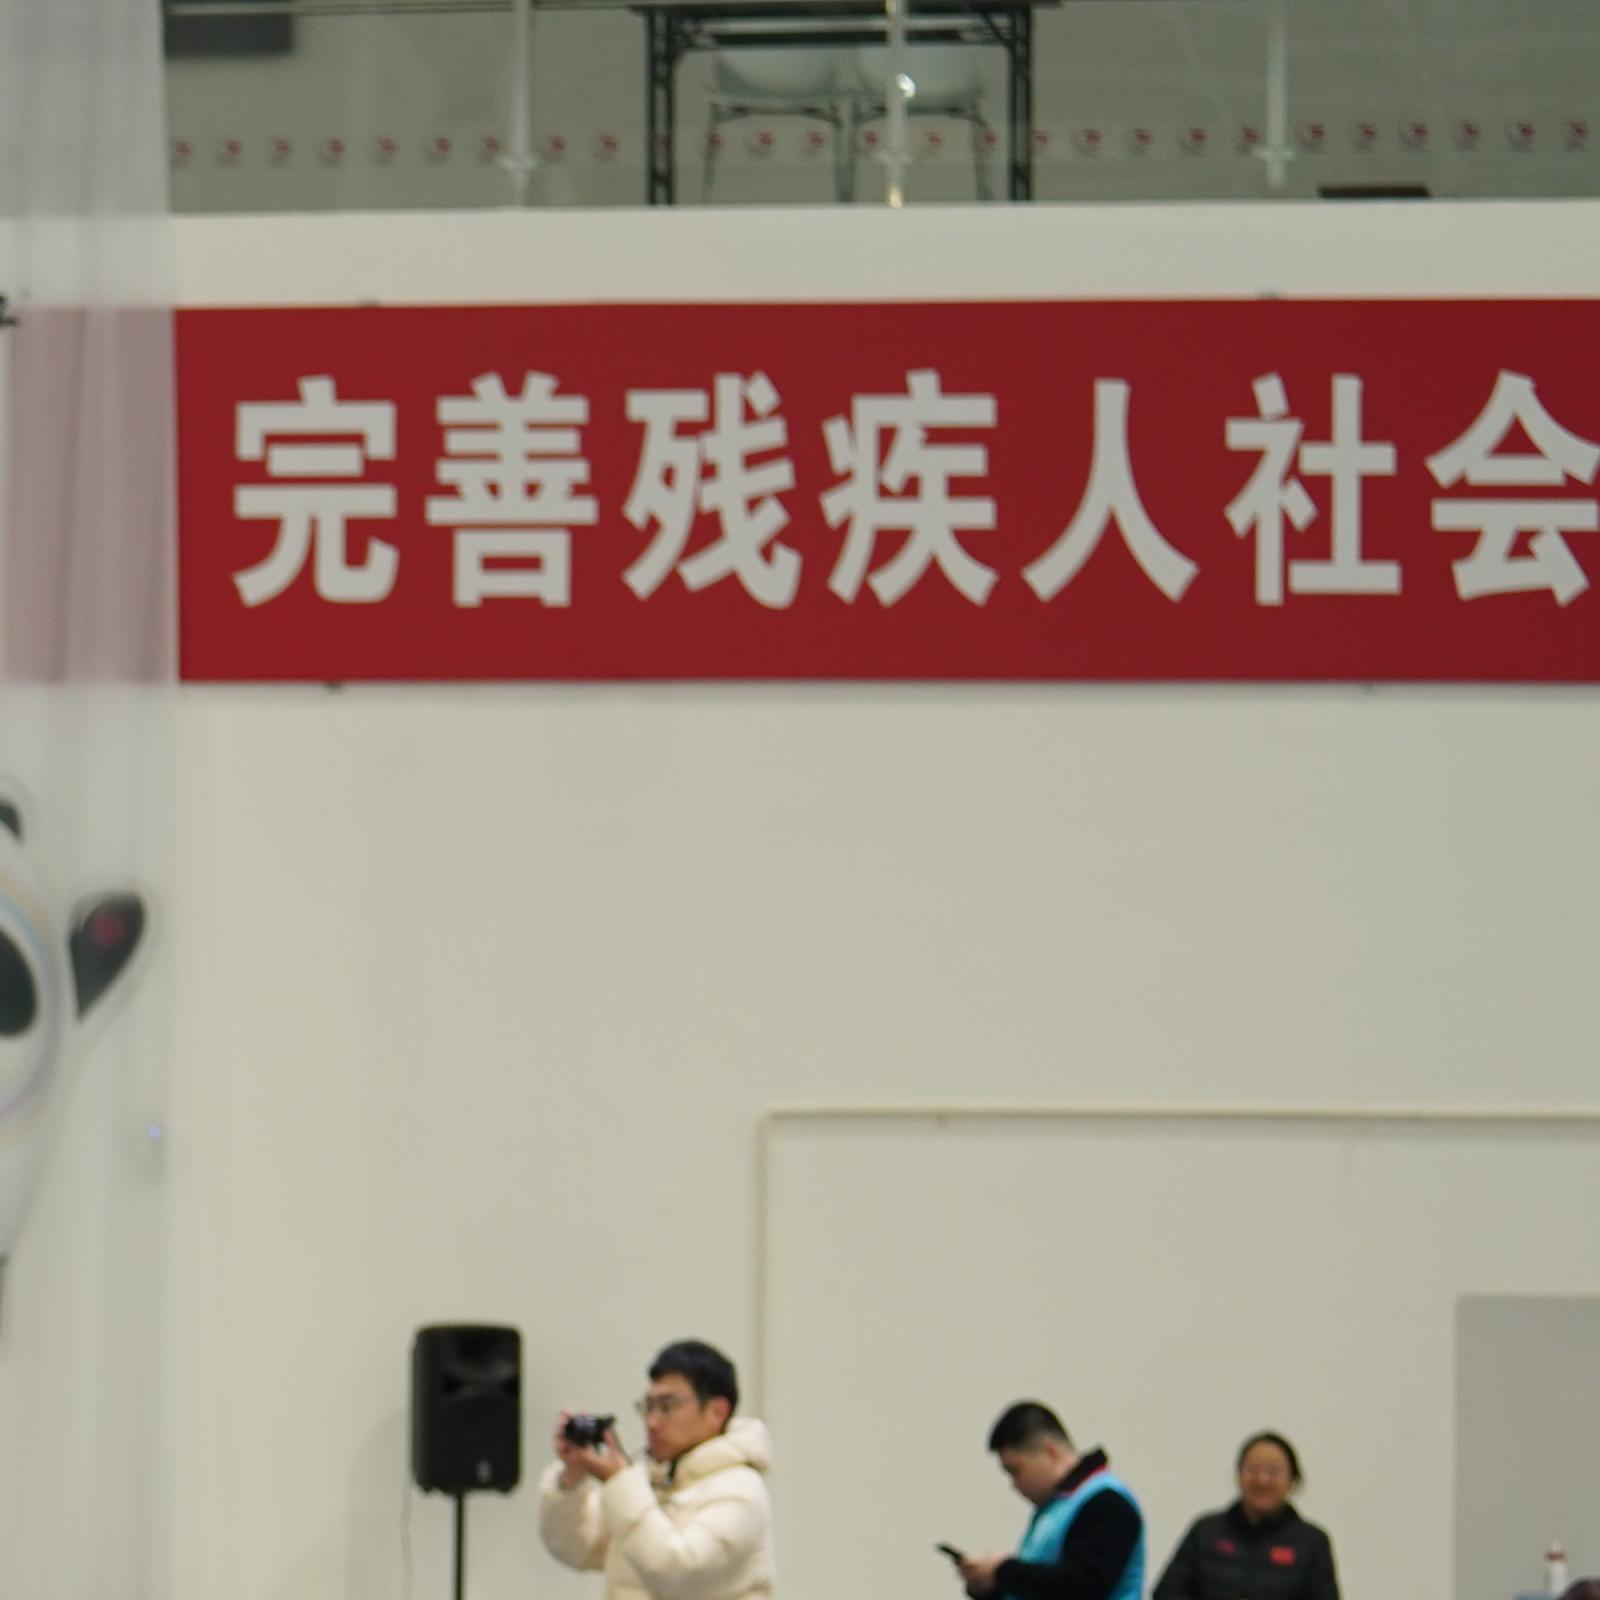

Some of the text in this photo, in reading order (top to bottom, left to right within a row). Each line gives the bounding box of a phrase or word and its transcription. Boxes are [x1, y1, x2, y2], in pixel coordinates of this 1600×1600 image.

[231, 367, 1600, 610] 完善残疾人社会
